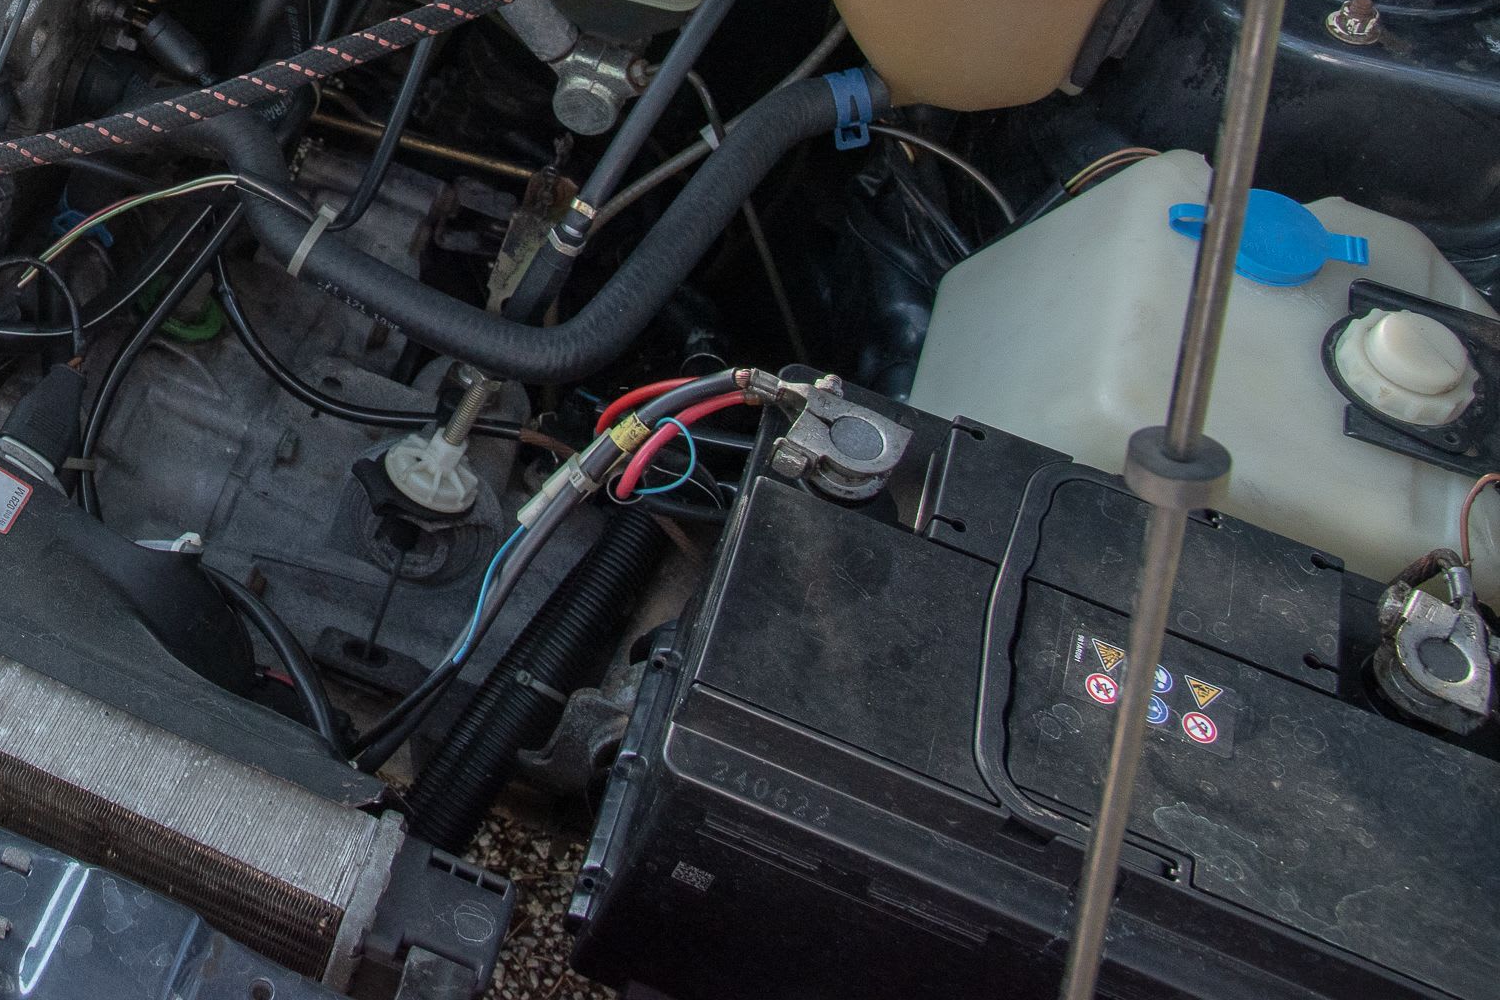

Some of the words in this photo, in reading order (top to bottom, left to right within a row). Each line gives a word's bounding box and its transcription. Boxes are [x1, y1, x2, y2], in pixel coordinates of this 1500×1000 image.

[7, 495, 20, 510] 029
[15, 486, 26, 497] M
[711, 760, 830, 827] 240622
